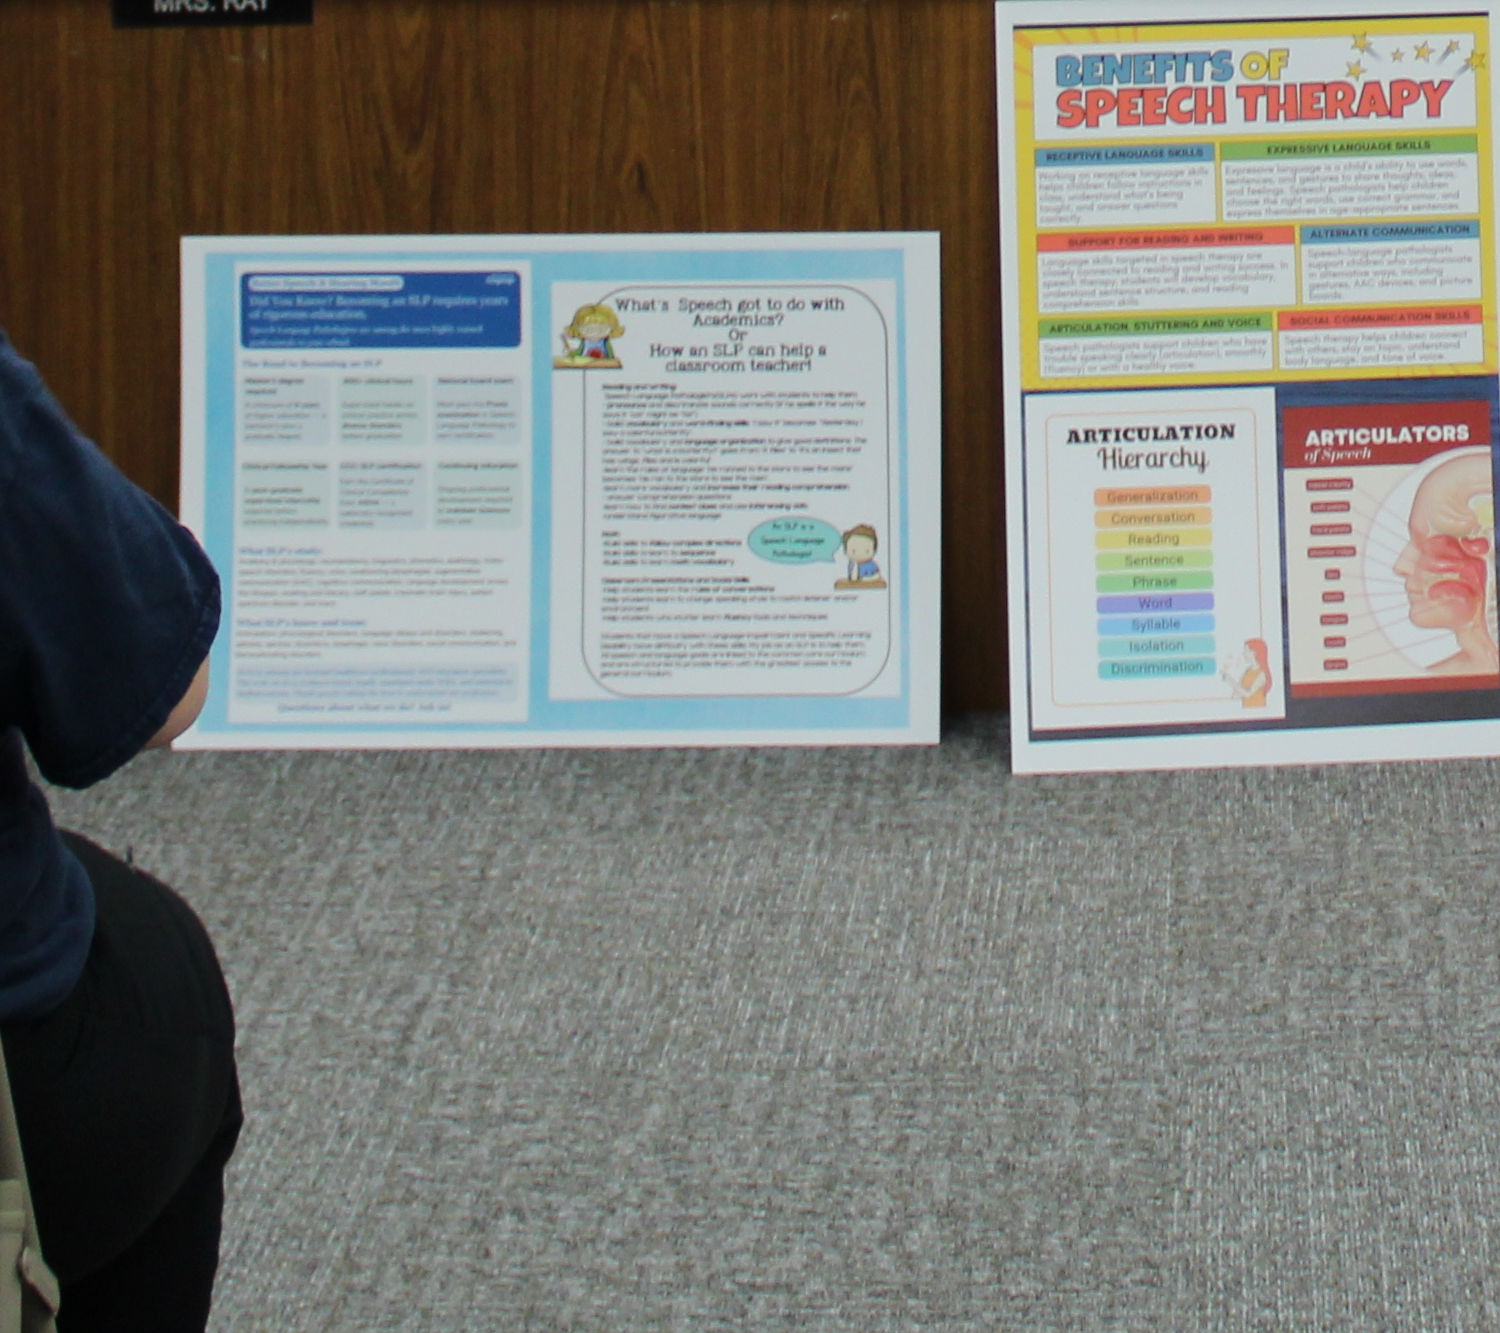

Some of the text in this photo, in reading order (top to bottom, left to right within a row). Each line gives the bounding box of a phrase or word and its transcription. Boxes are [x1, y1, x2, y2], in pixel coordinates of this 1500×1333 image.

[1056, 48, 1289, 86] BENEFITS OF
[1056, 78, 1454, 128] SPEECH THERAPY
[1046, 149, 1203, 161] RECEPTIVE LANGUAGE SKILLS
[1267, 141, 1430, 155] EXPRESSIVE LANGUAGE SKILLS
[1311, 225, 1470, 240] ALTERNATE COMMUNICATION
[1068, 233, 1263, 247] SUPPORT FOR READING AND WRITING
[615, 298, 845, 313] What's Speech got to do with
[693, 314, 784, 327] Academics?
[1133, 319, 1199, 332] STUTTERING
[1201, 319, 1225, 329] AND
[1228, 317, 1261, 328] VOICE
[1290, 310, 1471, 326] SOCIAL COMMUNICATION SKILLS
[729, 328, 748, 342] Or
[650, 343, 827, 358] How an SLP can help a
[665, 360, 745, 372] classroom
[1066, 423, 1236, 445] ARTICULATION
[1305, 424, 1470, 447] ARTICULATORS
[1097, 446, 1209, 474] Hierarchy
[1304, 446, 1372, 464] of Speech
[1107, 490, 1198, 504] Generalization
[1111, 511, 1195, 525] Conversation
[1128, 533, 1180, 546] Reading
[1125, 555, 1184, 567] Sentence
[1132, 576, 1177, 589] Phrase
[1138, 596, 1172, 609] Word
[1132, 617, 1181, 633] Syllable
[1129, 640, 1184, 652] Isolation
[1111, 661, 1203, 675] Discrimination
